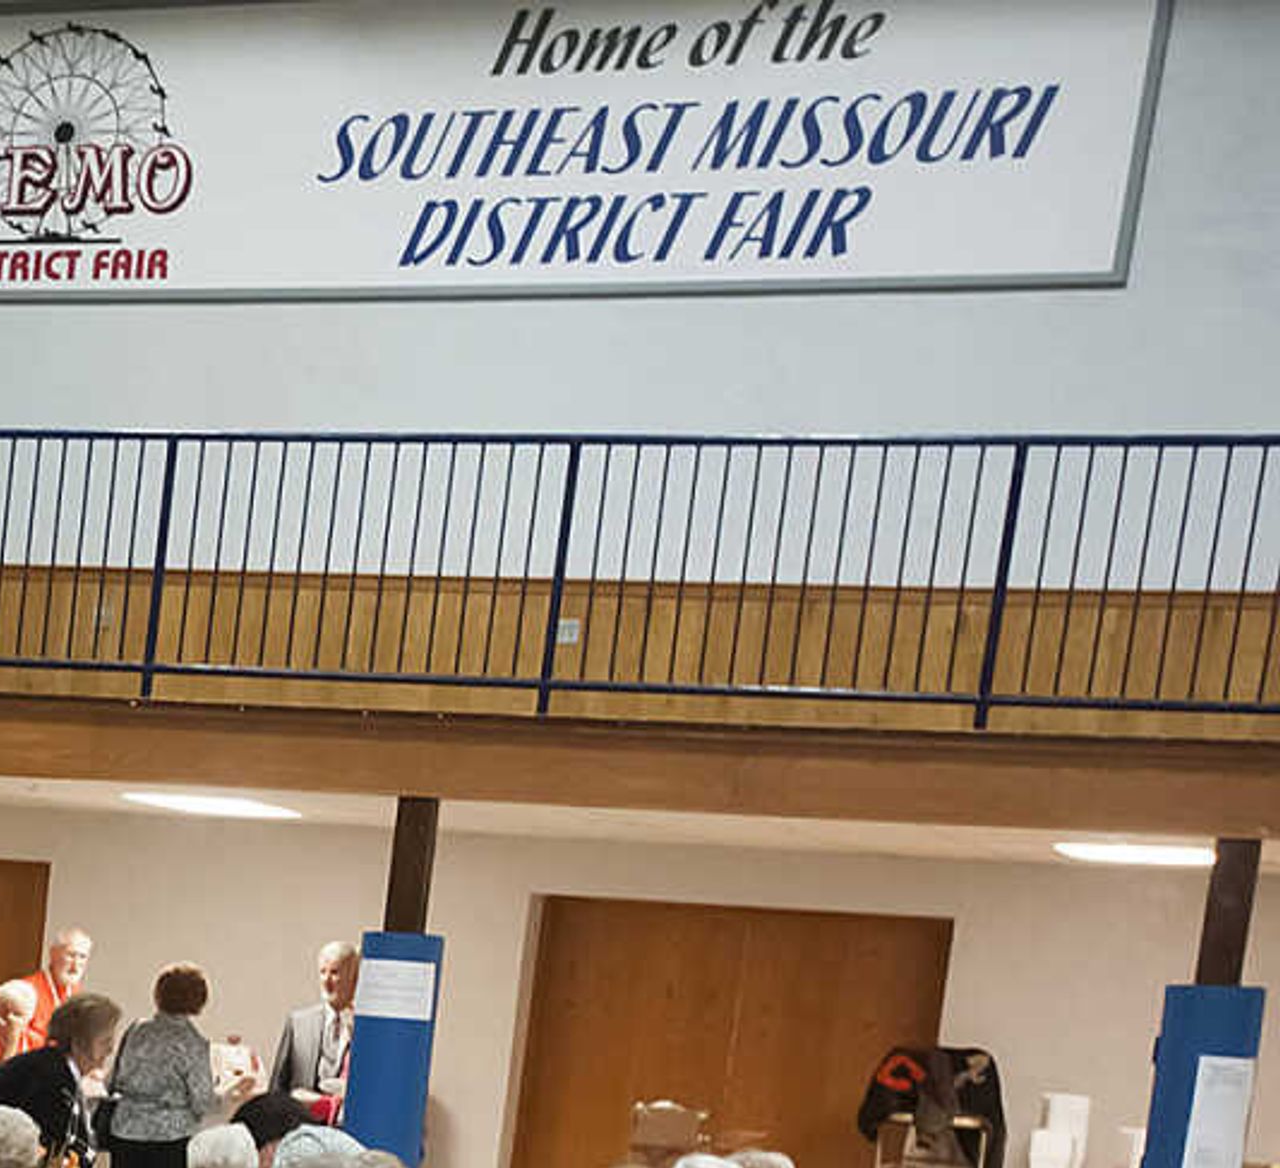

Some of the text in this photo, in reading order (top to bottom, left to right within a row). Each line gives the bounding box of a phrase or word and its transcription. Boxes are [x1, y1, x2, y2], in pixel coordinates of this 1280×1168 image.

[490, 0, 887, 76] Home of the
[317, 84, 1060, 184] SOUTHEAST MISSOURI
[91, 247, 170, 280] FAIR
[397, 185, 873, 268] DISTRICT FAIR
